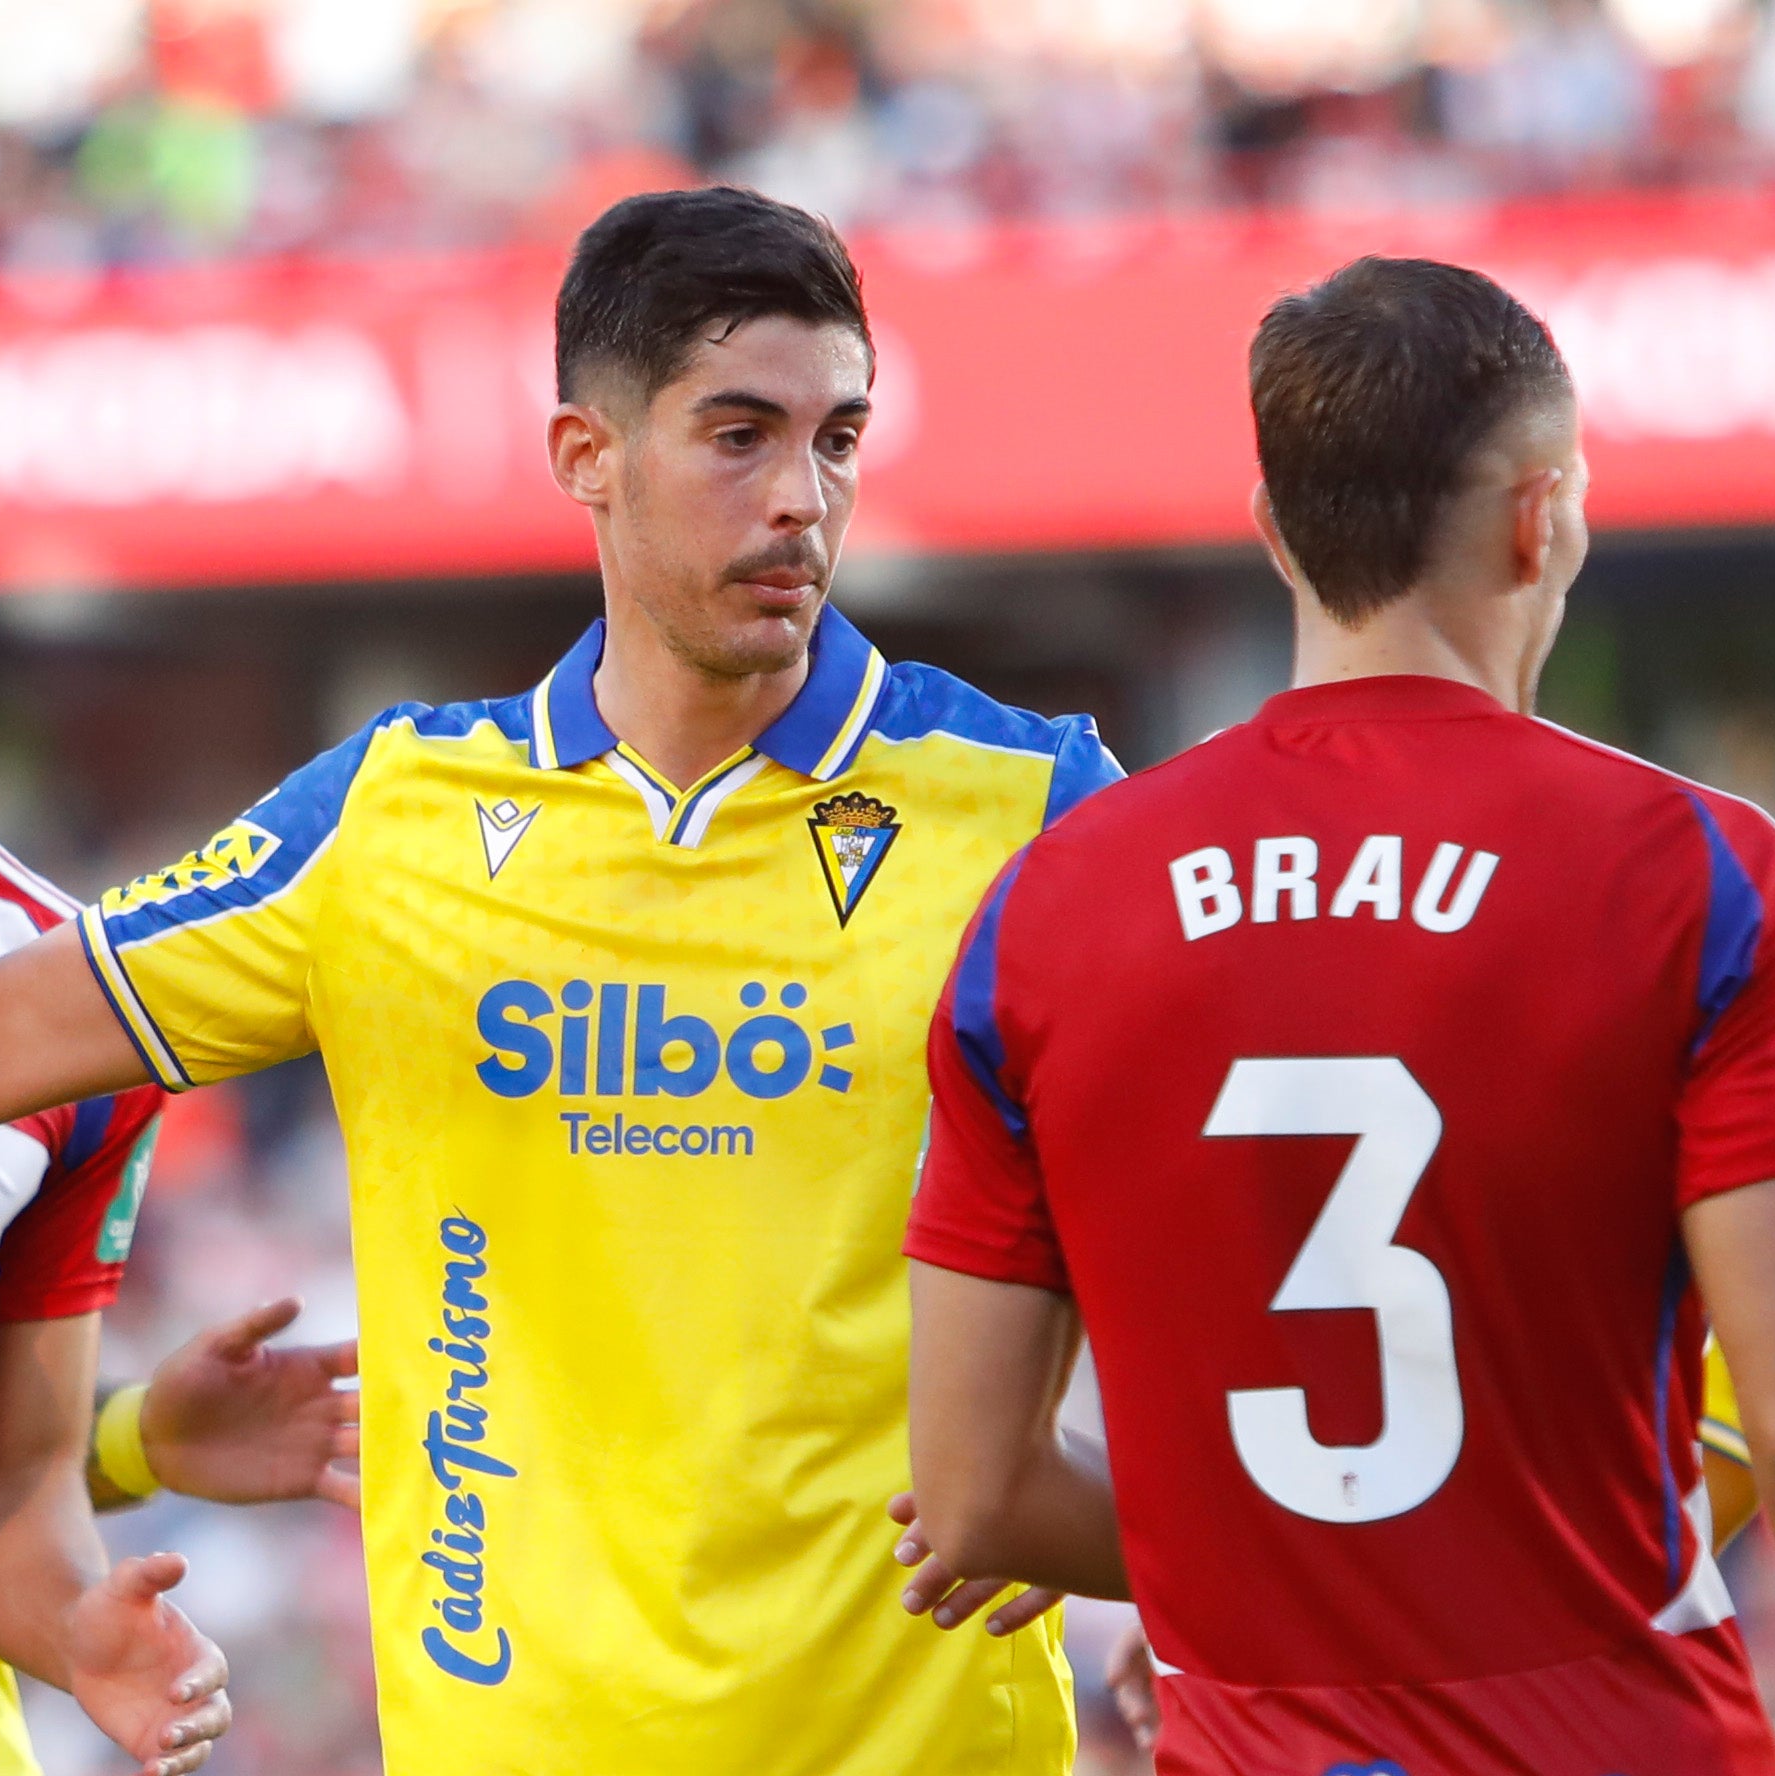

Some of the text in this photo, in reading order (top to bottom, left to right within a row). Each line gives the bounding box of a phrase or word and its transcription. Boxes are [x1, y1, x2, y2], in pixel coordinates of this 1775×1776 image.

[1168, 834, 1500, 942] BRAU
[475, 978, 812, 1100] Silbö
[560, 1112, 755, 1156] Telecom
[1202, 1056, 1466, 1524] 3
